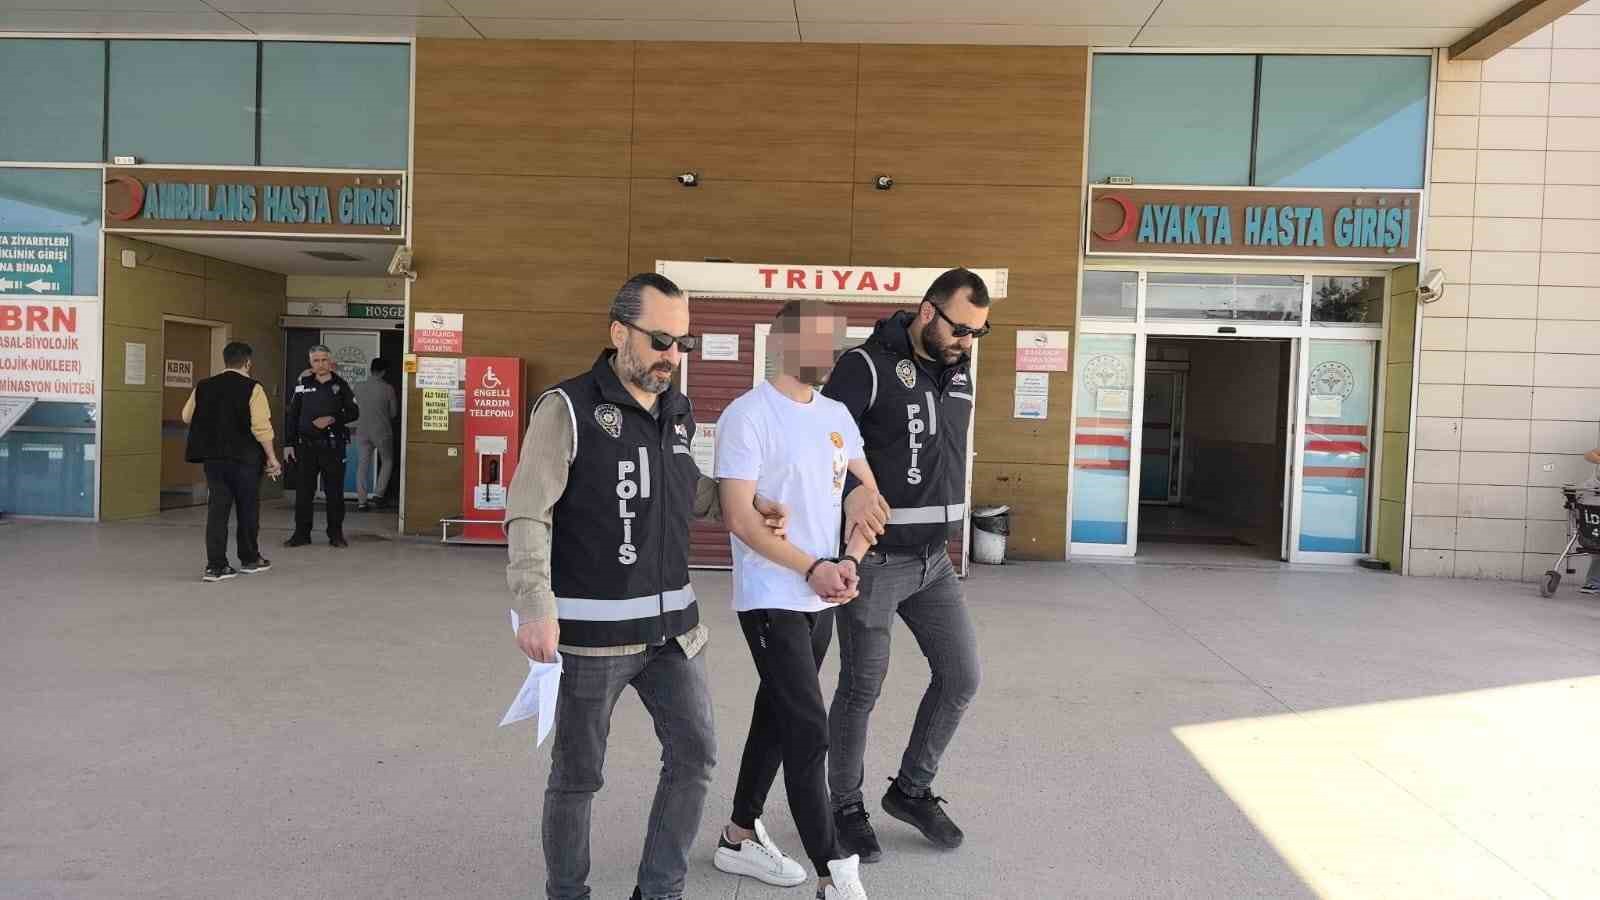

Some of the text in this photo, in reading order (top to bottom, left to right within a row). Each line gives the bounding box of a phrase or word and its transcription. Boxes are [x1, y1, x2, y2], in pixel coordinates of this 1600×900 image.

[143, 177, 401, 231] AMBULANS HASTA GİRİŞİ
[1137, 198, 1412, 254] AYAKTA HASTA GİRİŞİ
[11, 234, 69, 247] ZİYARETLERİ
[168, 362, 190, 374] KBRN
[473, 388, 511, 397] ENGELLİ
[474, 398, 510, 407] YARDIM
[469, 409, 514, 418] TELEFONU
[906, 404, 925, 485] POLİS
[616, 461, 638, 565] POLİS
